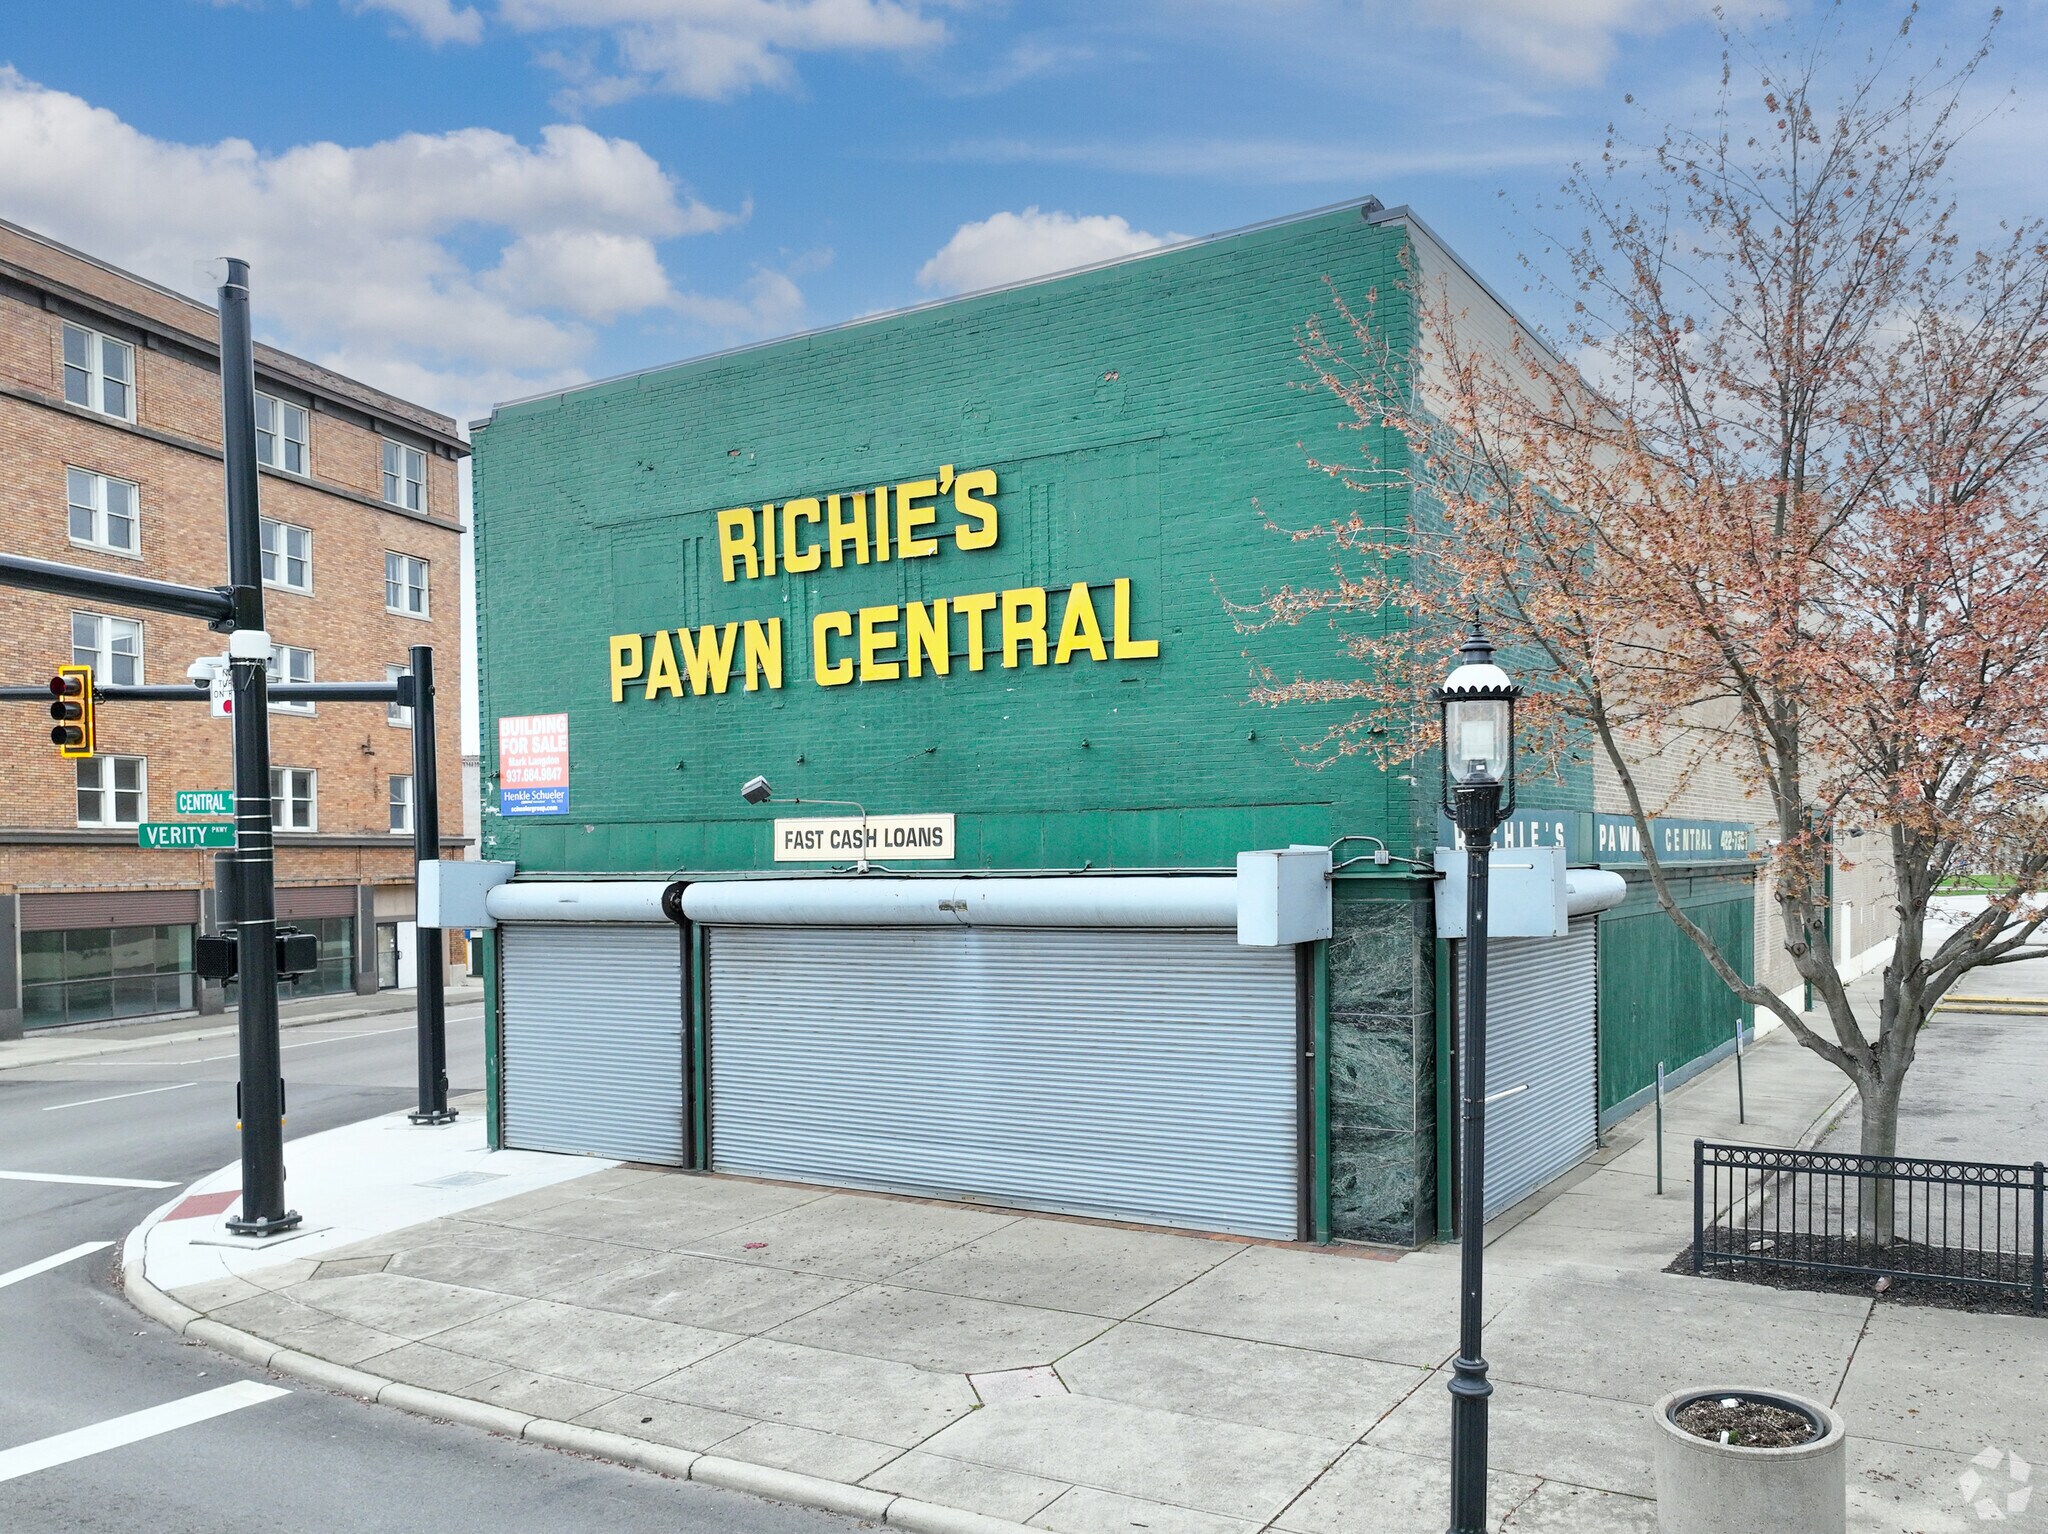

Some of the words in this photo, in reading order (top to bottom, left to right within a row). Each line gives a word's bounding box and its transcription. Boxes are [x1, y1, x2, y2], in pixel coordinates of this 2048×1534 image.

[717, 464, 998, 582] RICHIE'S
[609, 617, 783, 703] PAWN
[813, 577, 1159, 686] CENTRAL
[214, 690, 224, 698] ON
[501, 715, 567, 736] BUILDING
[501, 736, 529, 755] FOR
[531, 734, 567, 753] SALE
[508, 756, 528, 766] Mark
[528, 755, 560, 767] Langdon
[506, 766, 563, 783] 937.684.9847
[179, 793, 226, 811] CENTRAL
[504, 790, 531, 801] Henkle
[531, 789, 565, 800] Schueler
[146, 825, 208, 845] VERITY
[784, 830, 824, 850] FAST
[830, 828, 877, 849] CASH
[884, 826, 943, 848] LOANS
[1454, 820, 1565, 850] RHIE'S
[1599, 824, 1640, 852] PAWN
[1665, 827, 1712, 852] CENTRAL
